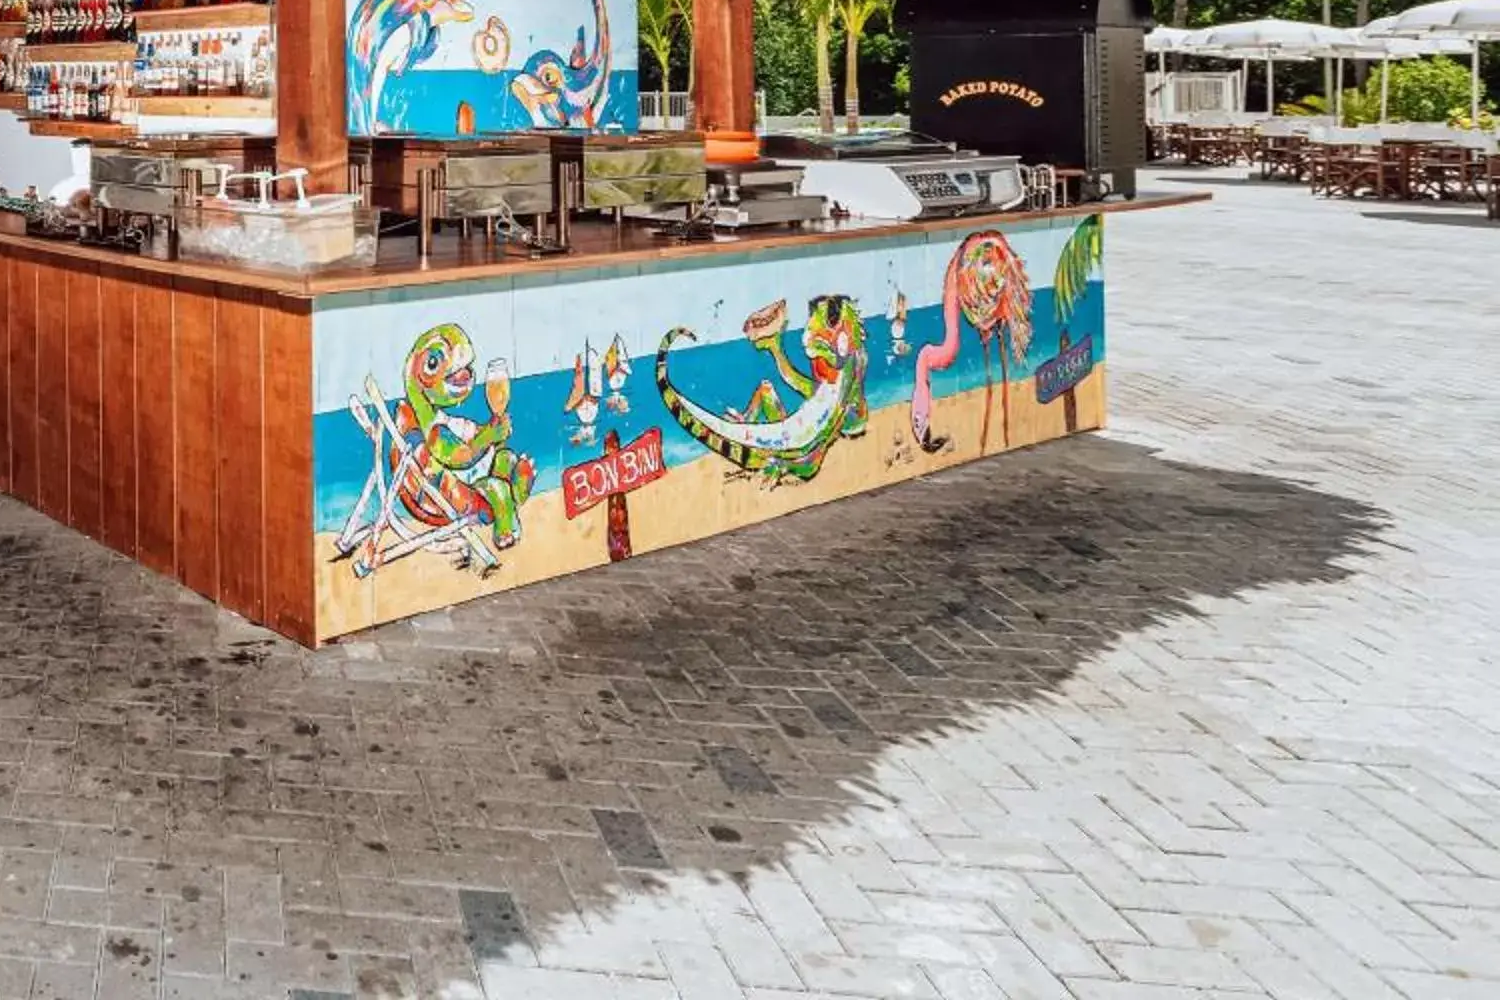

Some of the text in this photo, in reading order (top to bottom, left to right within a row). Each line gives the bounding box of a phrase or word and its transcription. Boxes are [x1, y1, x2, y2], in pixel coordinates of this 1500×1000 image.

[940, 81, 1044, 107] BAKED POTATO
[570, 442, 660, 505] BON BINI
